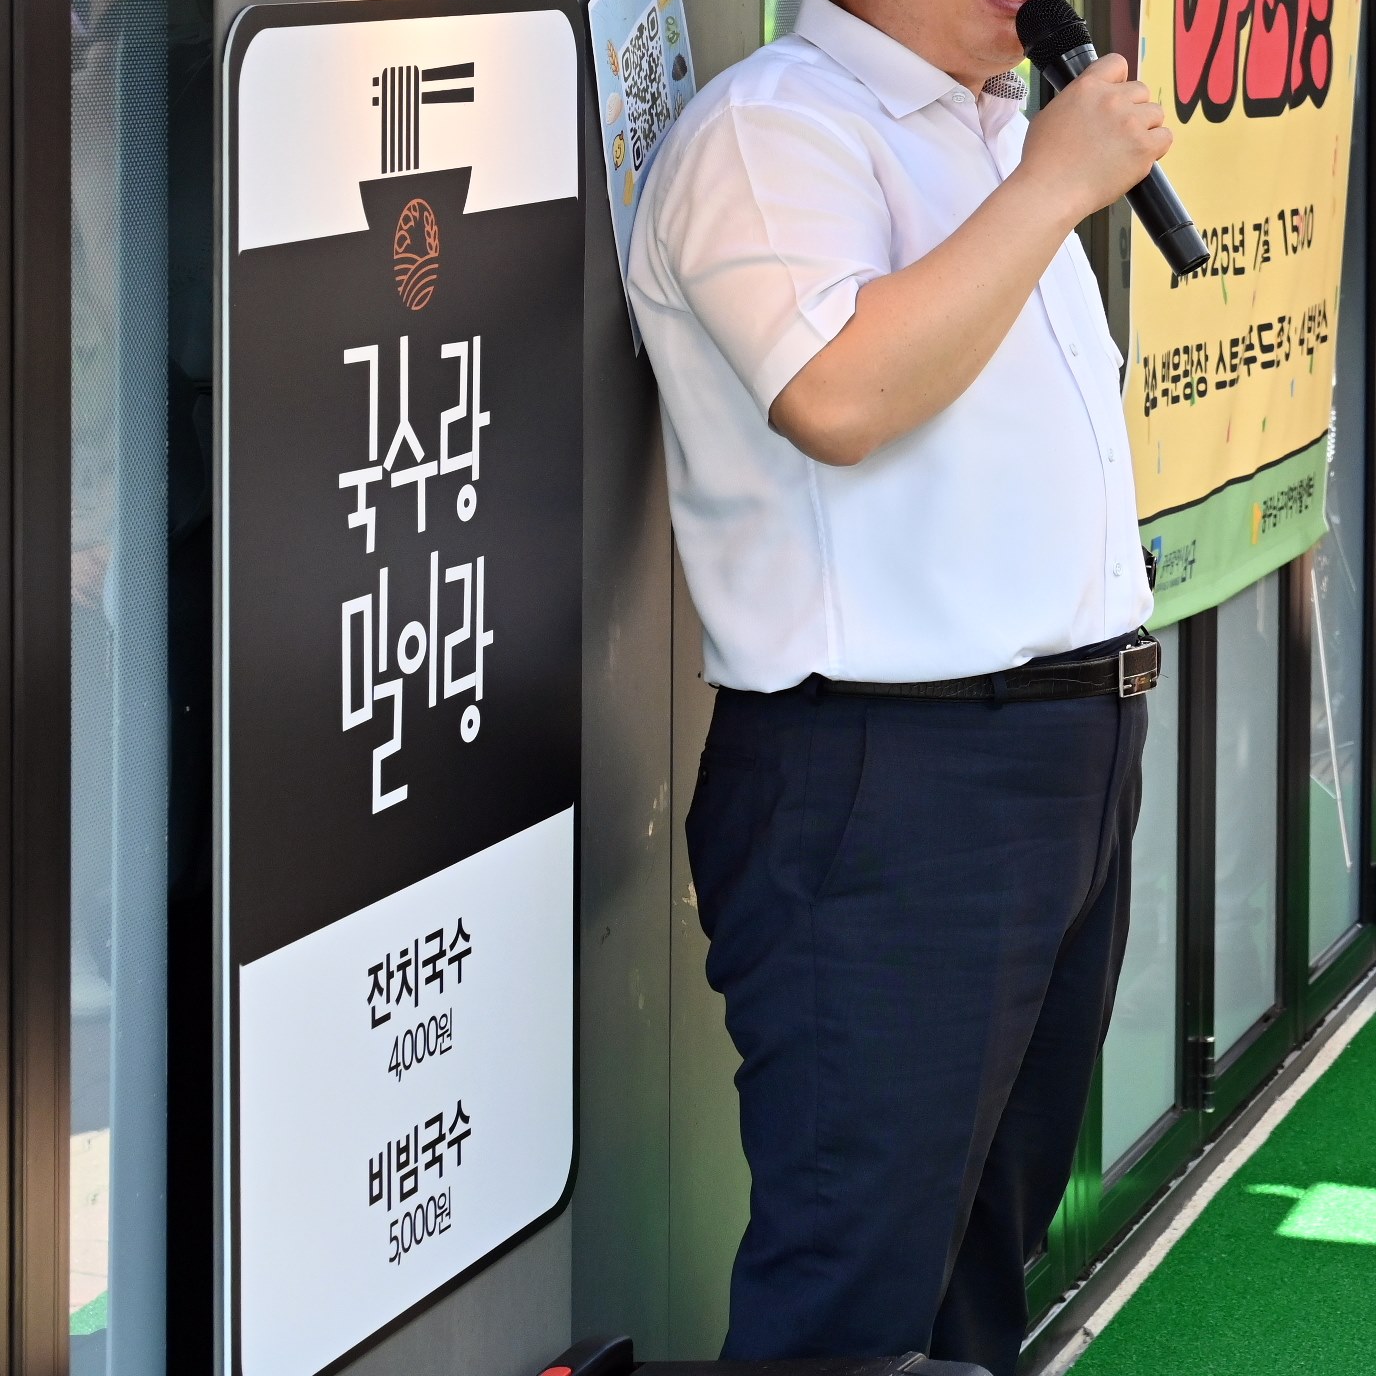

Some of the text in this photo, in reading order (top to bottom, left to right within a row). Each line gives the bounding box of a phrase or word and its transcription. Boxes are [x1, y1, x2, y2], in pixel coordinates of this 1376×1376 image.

[1190, 220, 1246, 280] 025년
[1160, 340, 1209, 408] 백운광장
[338, 335, 491, 554] 국수랑
[341, 550, 494, 814] 밀이랑
[366, 917, 472, 1030] 잔치국수
[387, 1007, 453, 1083] 4,000원
[368, 1099, 472, 1212] 비빔국수
[388, 1186, 452, 1266] 5,000원
